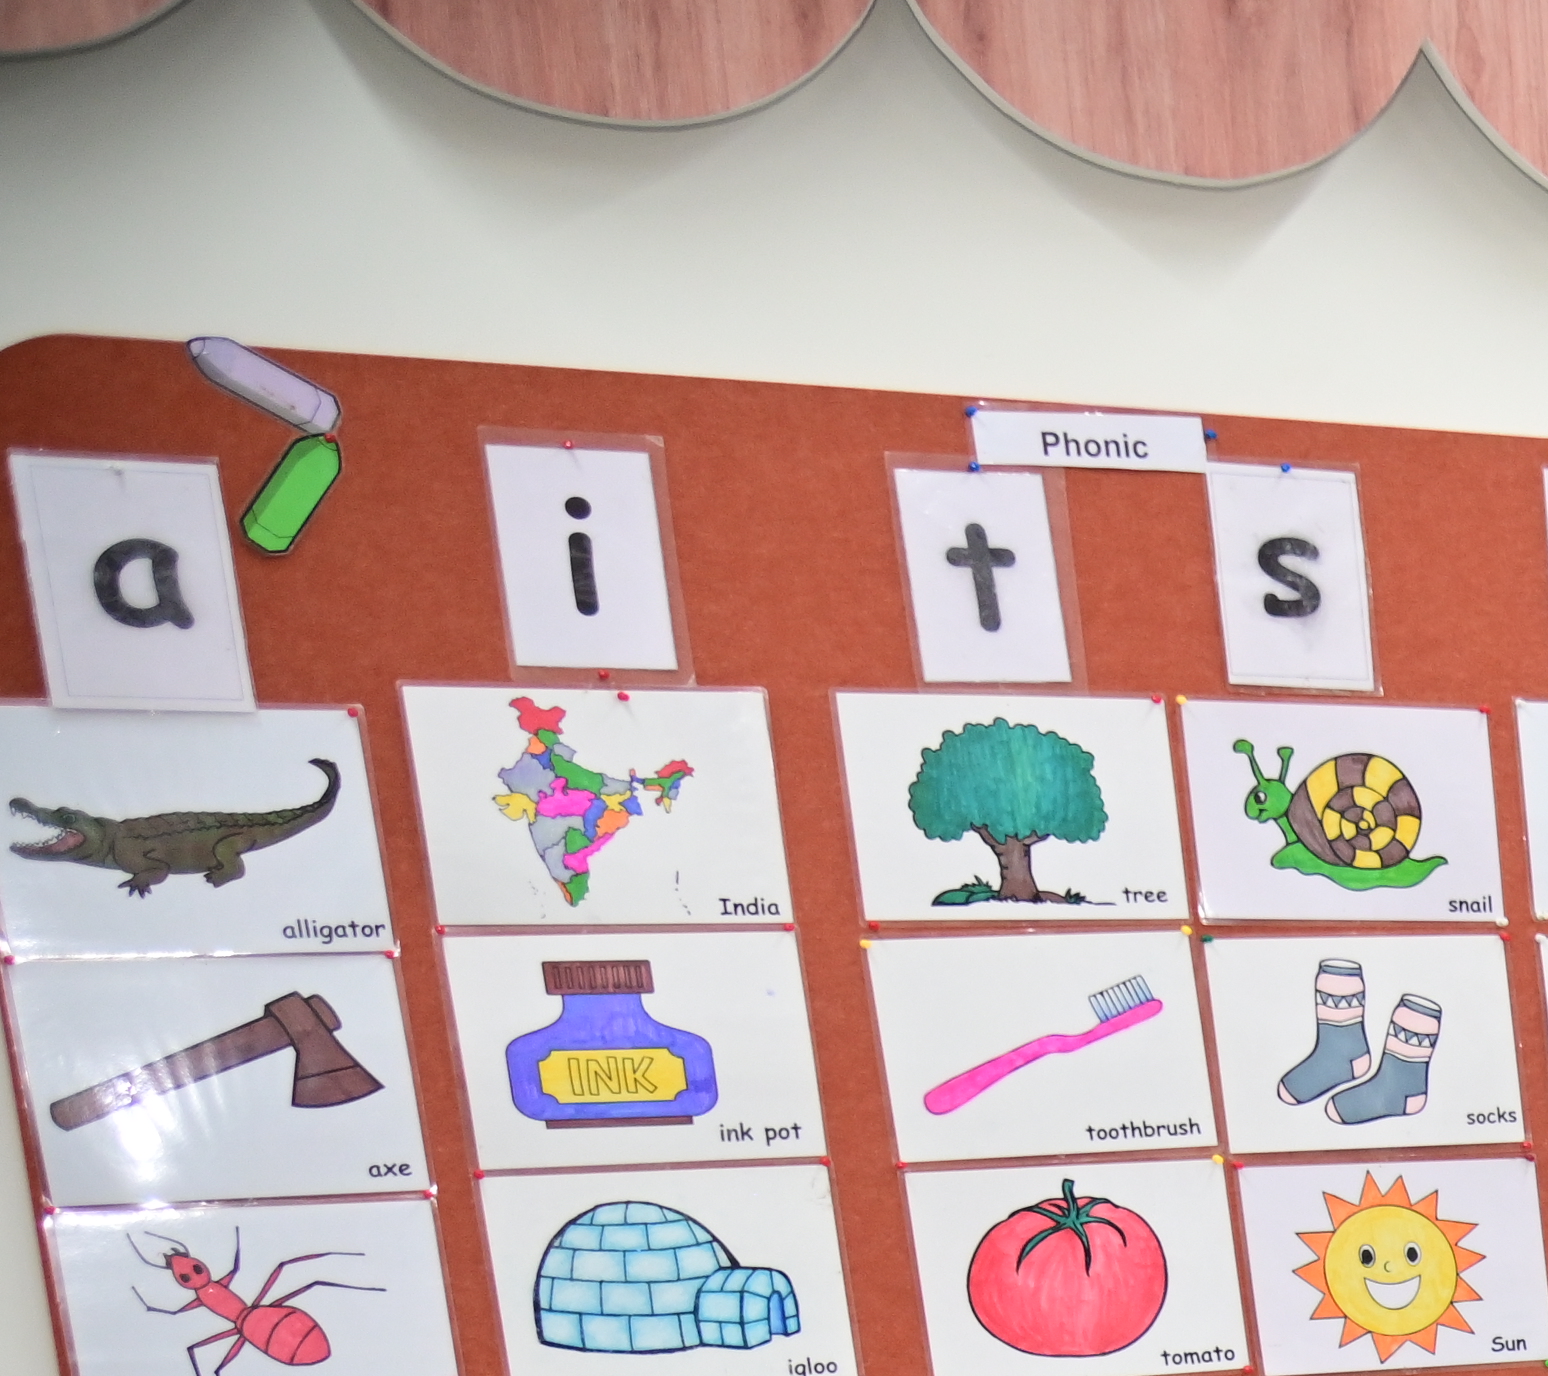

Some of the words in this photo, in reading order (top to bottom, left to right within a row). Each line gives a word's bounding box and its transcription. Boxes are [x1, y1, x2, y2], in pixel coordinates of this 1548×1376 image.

[1040, 429, 1149, 461] Phonic
[565, 496, 600, 616] i
[93, 537, 195, 630] a
[946, 523, 1016, 632] t
[1257, 537, 1321, 617] s
[718, 896, 781, 918] India
[1122, 887, 1168, 904] tree
[1448, 895, 1493, 914] snail
[282, 917, 387, 944] alligator
[567, 1055, 659, 1096] INK
[1466, 1106, 1518, 1126] socks
[718, 1120, 754, 1143] ink
[763, 1122, 803, 1147] pot
[1085, 1117, 1202, 1141] toothbrush
[368, 1161, 412, 1179] axe
[1490, 1334, 1528, 1353] Sun
[1160, 1346, 1236, 1367] tomato
